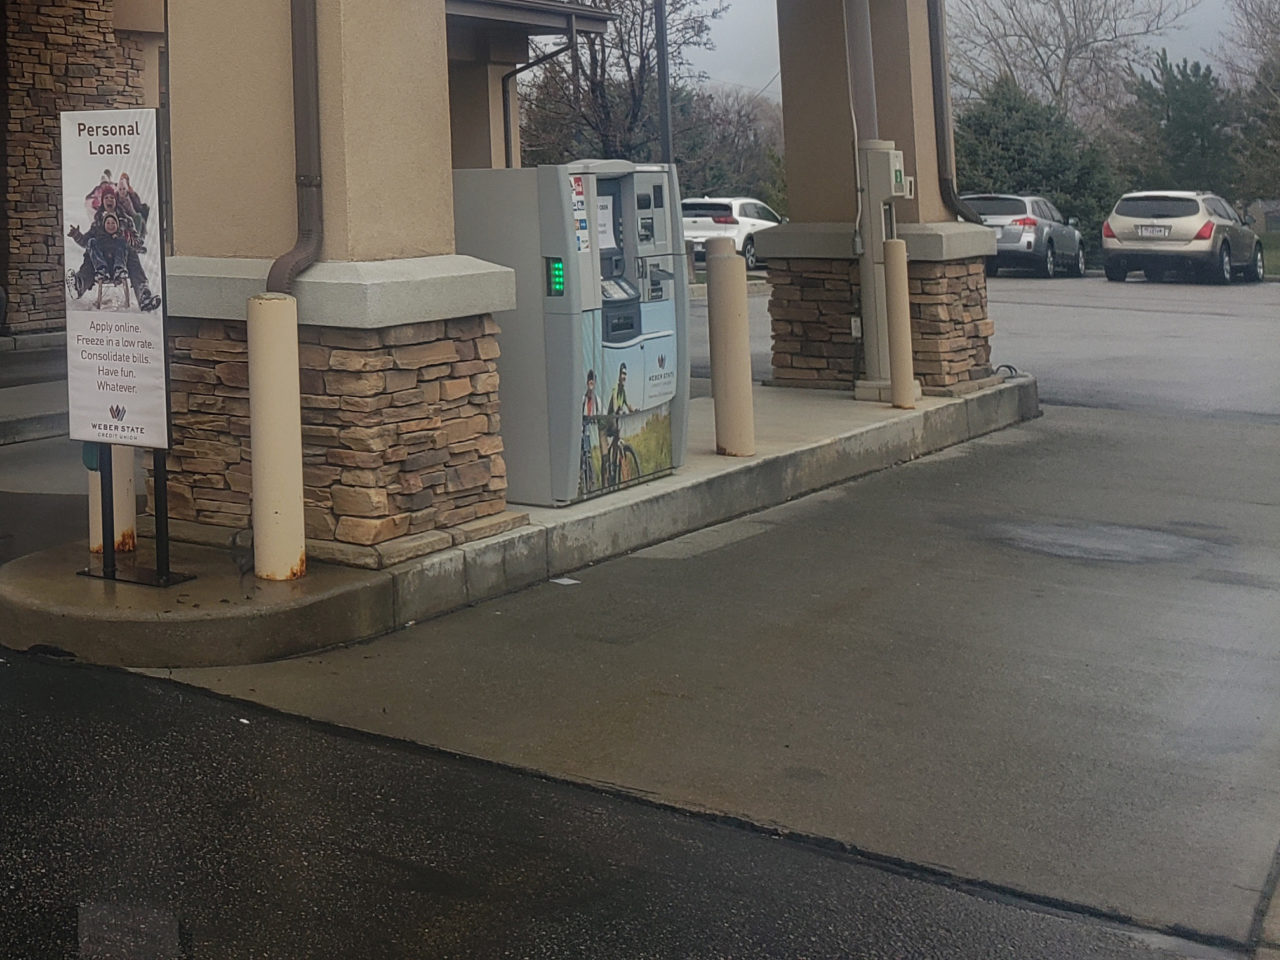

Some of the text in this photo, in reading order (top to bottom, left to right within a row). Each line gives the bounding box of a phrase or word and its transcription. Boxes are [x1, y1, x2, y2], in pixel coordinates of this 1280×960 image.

[77, 121, 140, 137] Personal
[89, 141, 130, 155] Loans
[89, 321, 142, 334] Apply online.
[76, 334, 105, 346] Freeze
[106, 336, 114, 346] in
[122, 337, 136, 348] low
[136, 339, 155, 349] rate.
[81, 350, 151, 364] Consolidate bills.
[98, 365, 136, 378] Have fun.
[96, 381, 137, 394] Whatever.
[91, 422, 145, 434] WEBER STATE
